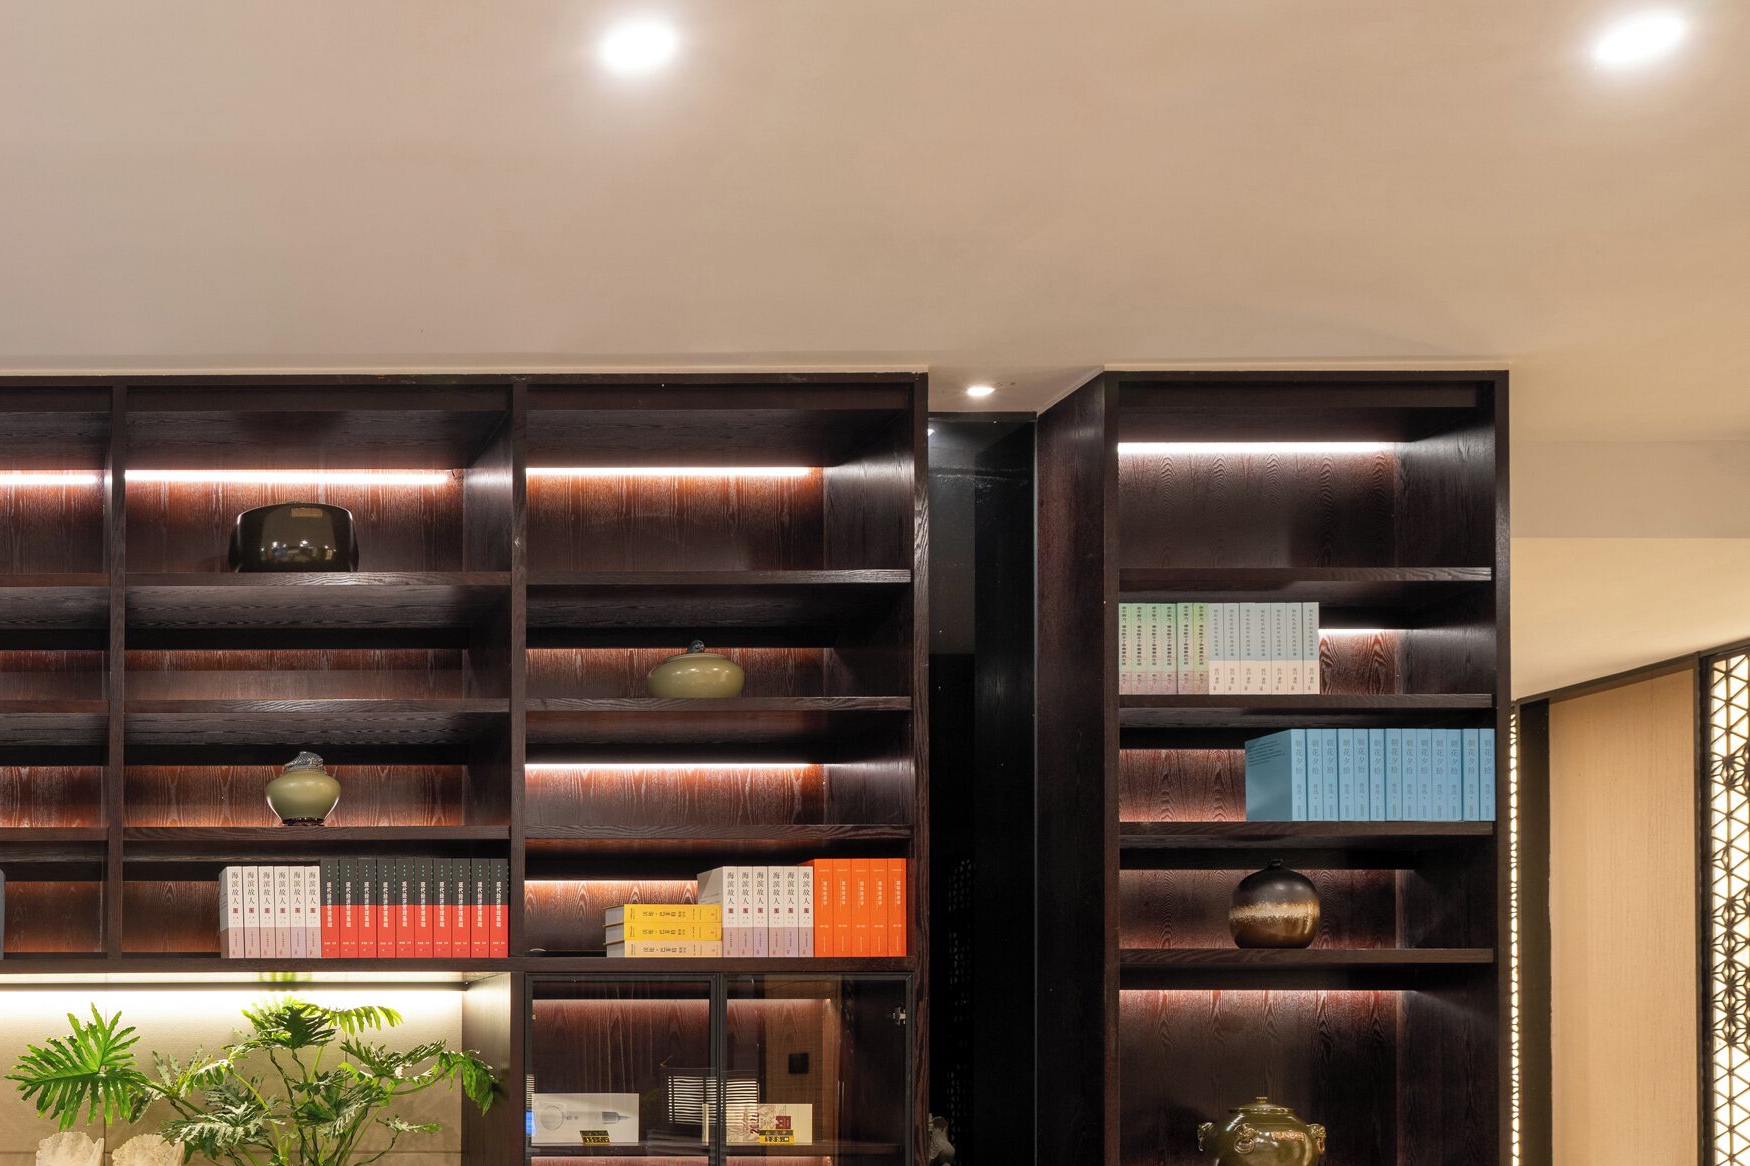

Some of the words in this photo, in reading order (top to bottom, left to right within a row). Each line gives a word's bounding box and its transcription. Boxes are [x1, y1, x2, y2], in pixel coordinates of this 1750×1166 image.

[247, 872, 255, 905] 海滨故人
[787, 872, 795, 905] 海滨故人
[802, 872, 810, 905] 海滨故人
